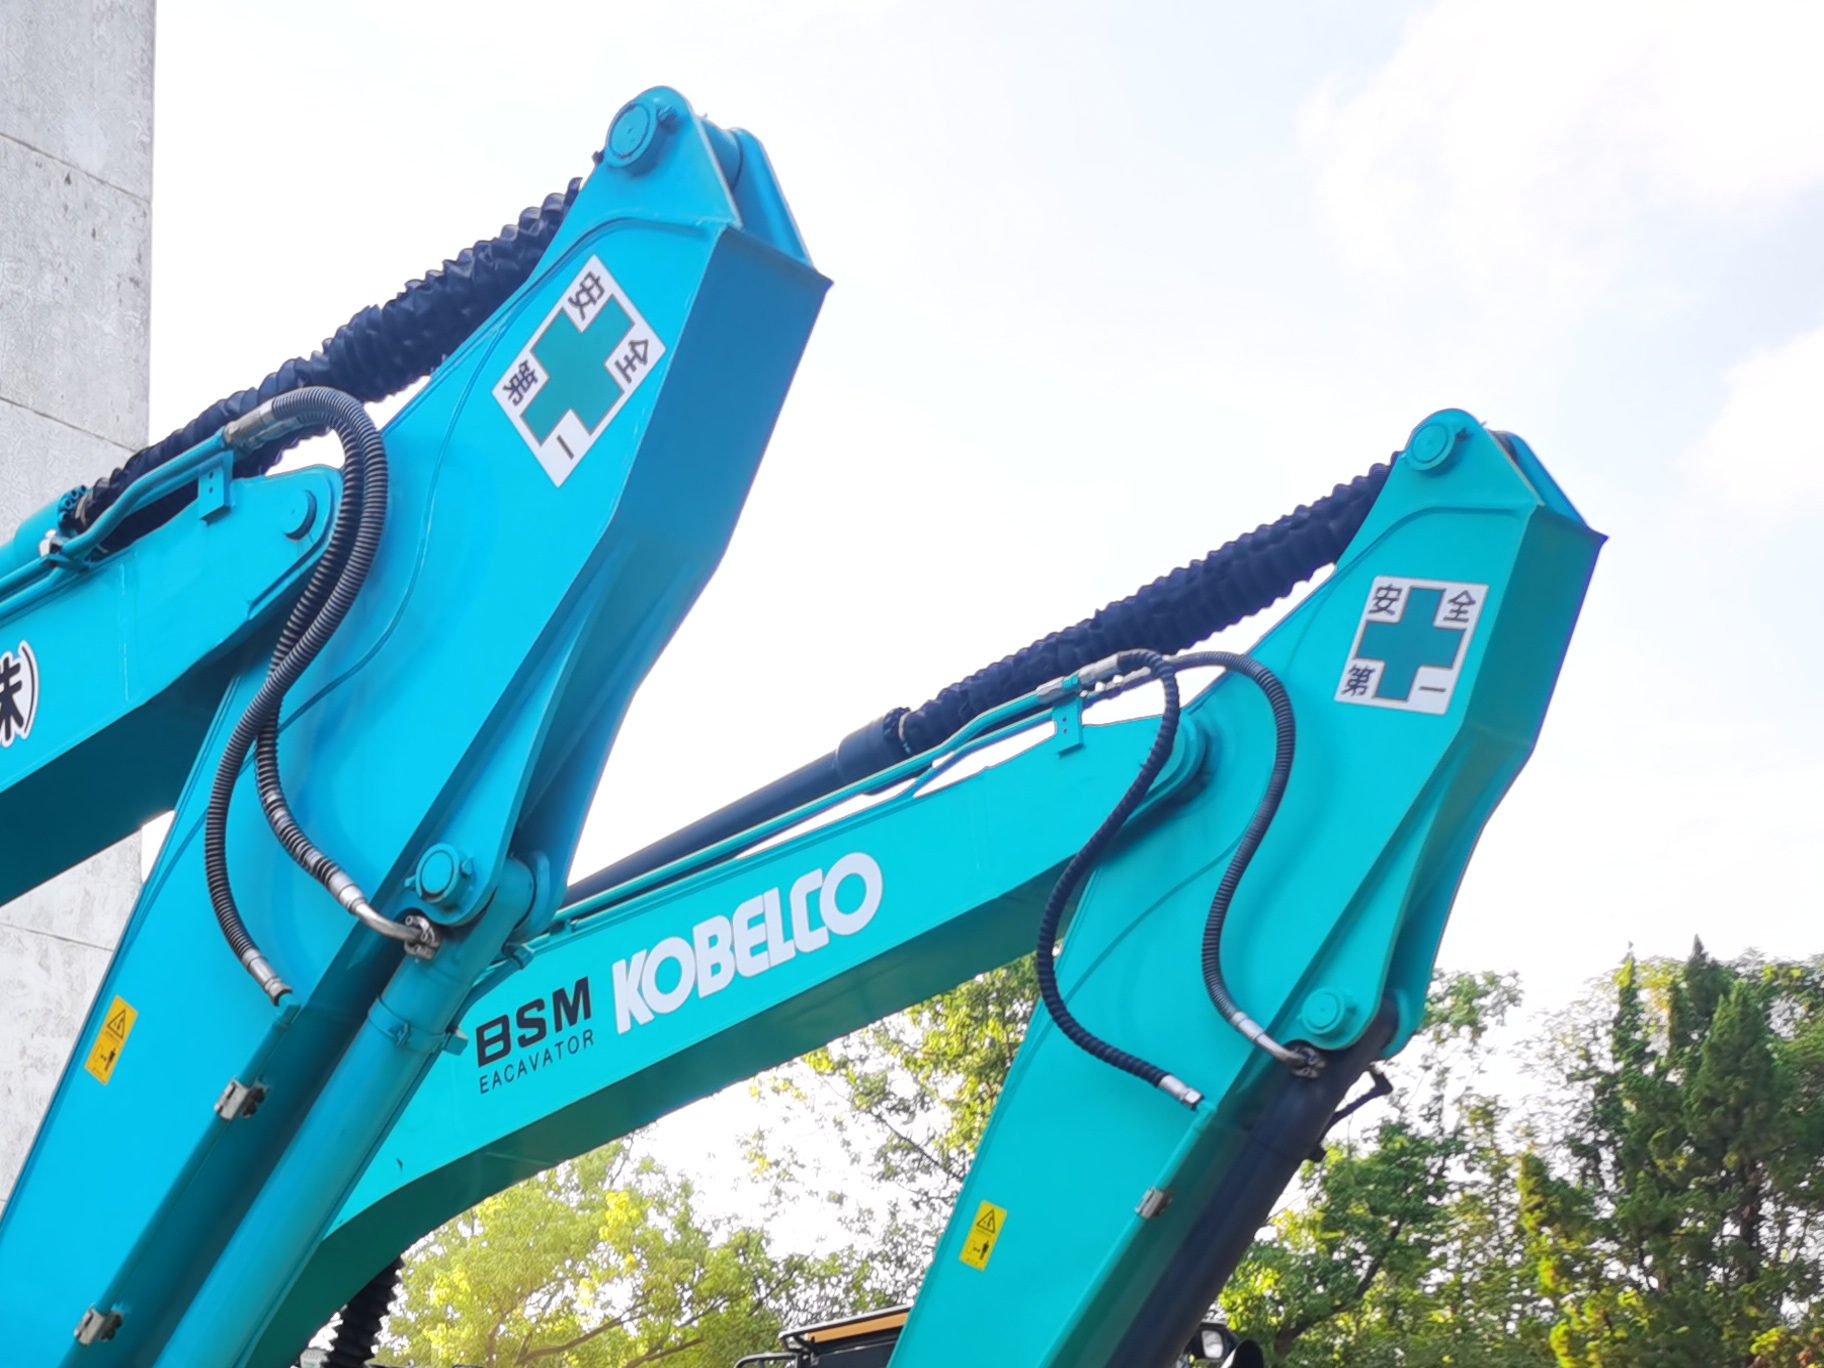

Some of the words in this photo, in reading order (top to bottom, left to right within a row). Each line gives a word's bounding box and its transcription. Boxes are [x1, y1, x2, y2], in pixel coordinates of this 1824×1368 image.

[612, 852, 883, 1035] KOBELCO
[476, 976, 591, 1067] BSM
[479, 1028, 594, 1094] EACAVATOR
